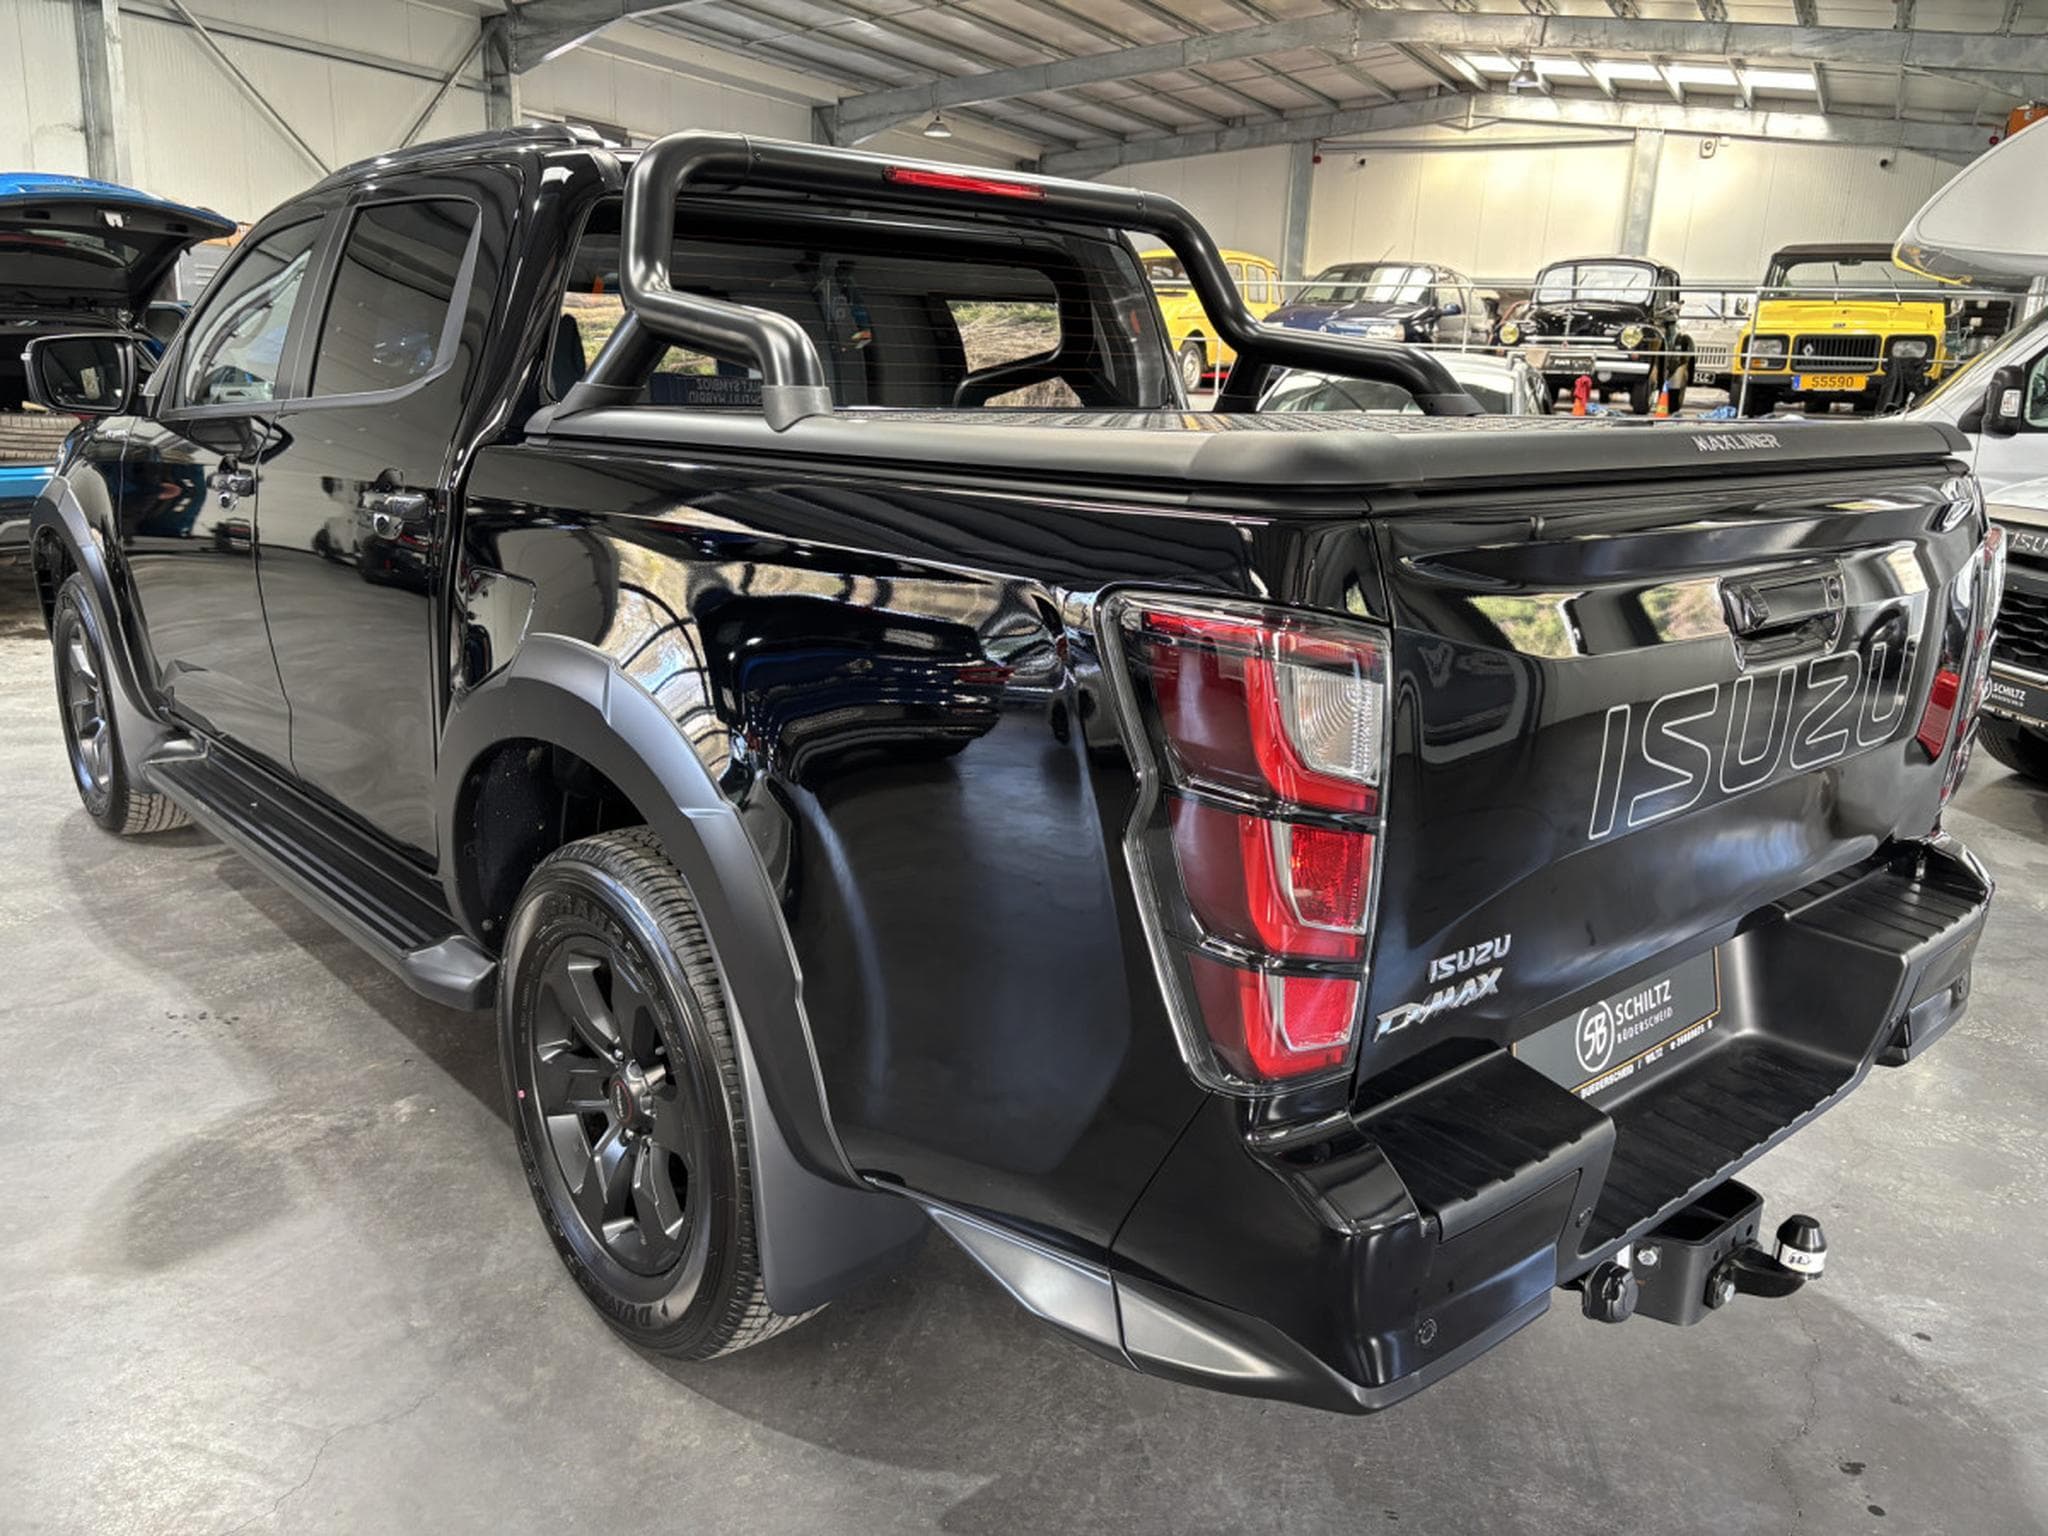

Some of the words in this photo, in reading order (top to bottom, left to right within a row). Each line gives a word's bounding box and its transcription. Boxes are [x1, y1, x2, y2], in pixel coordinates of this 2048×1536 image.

[1690, 432, 1782, 452] MAXLINER
[1588, 634, 1918, 841] ISUZU
[1427, 933, 1512, 984] ISUZU
[1614, 979, 1672, 1026] SCHILTZ
